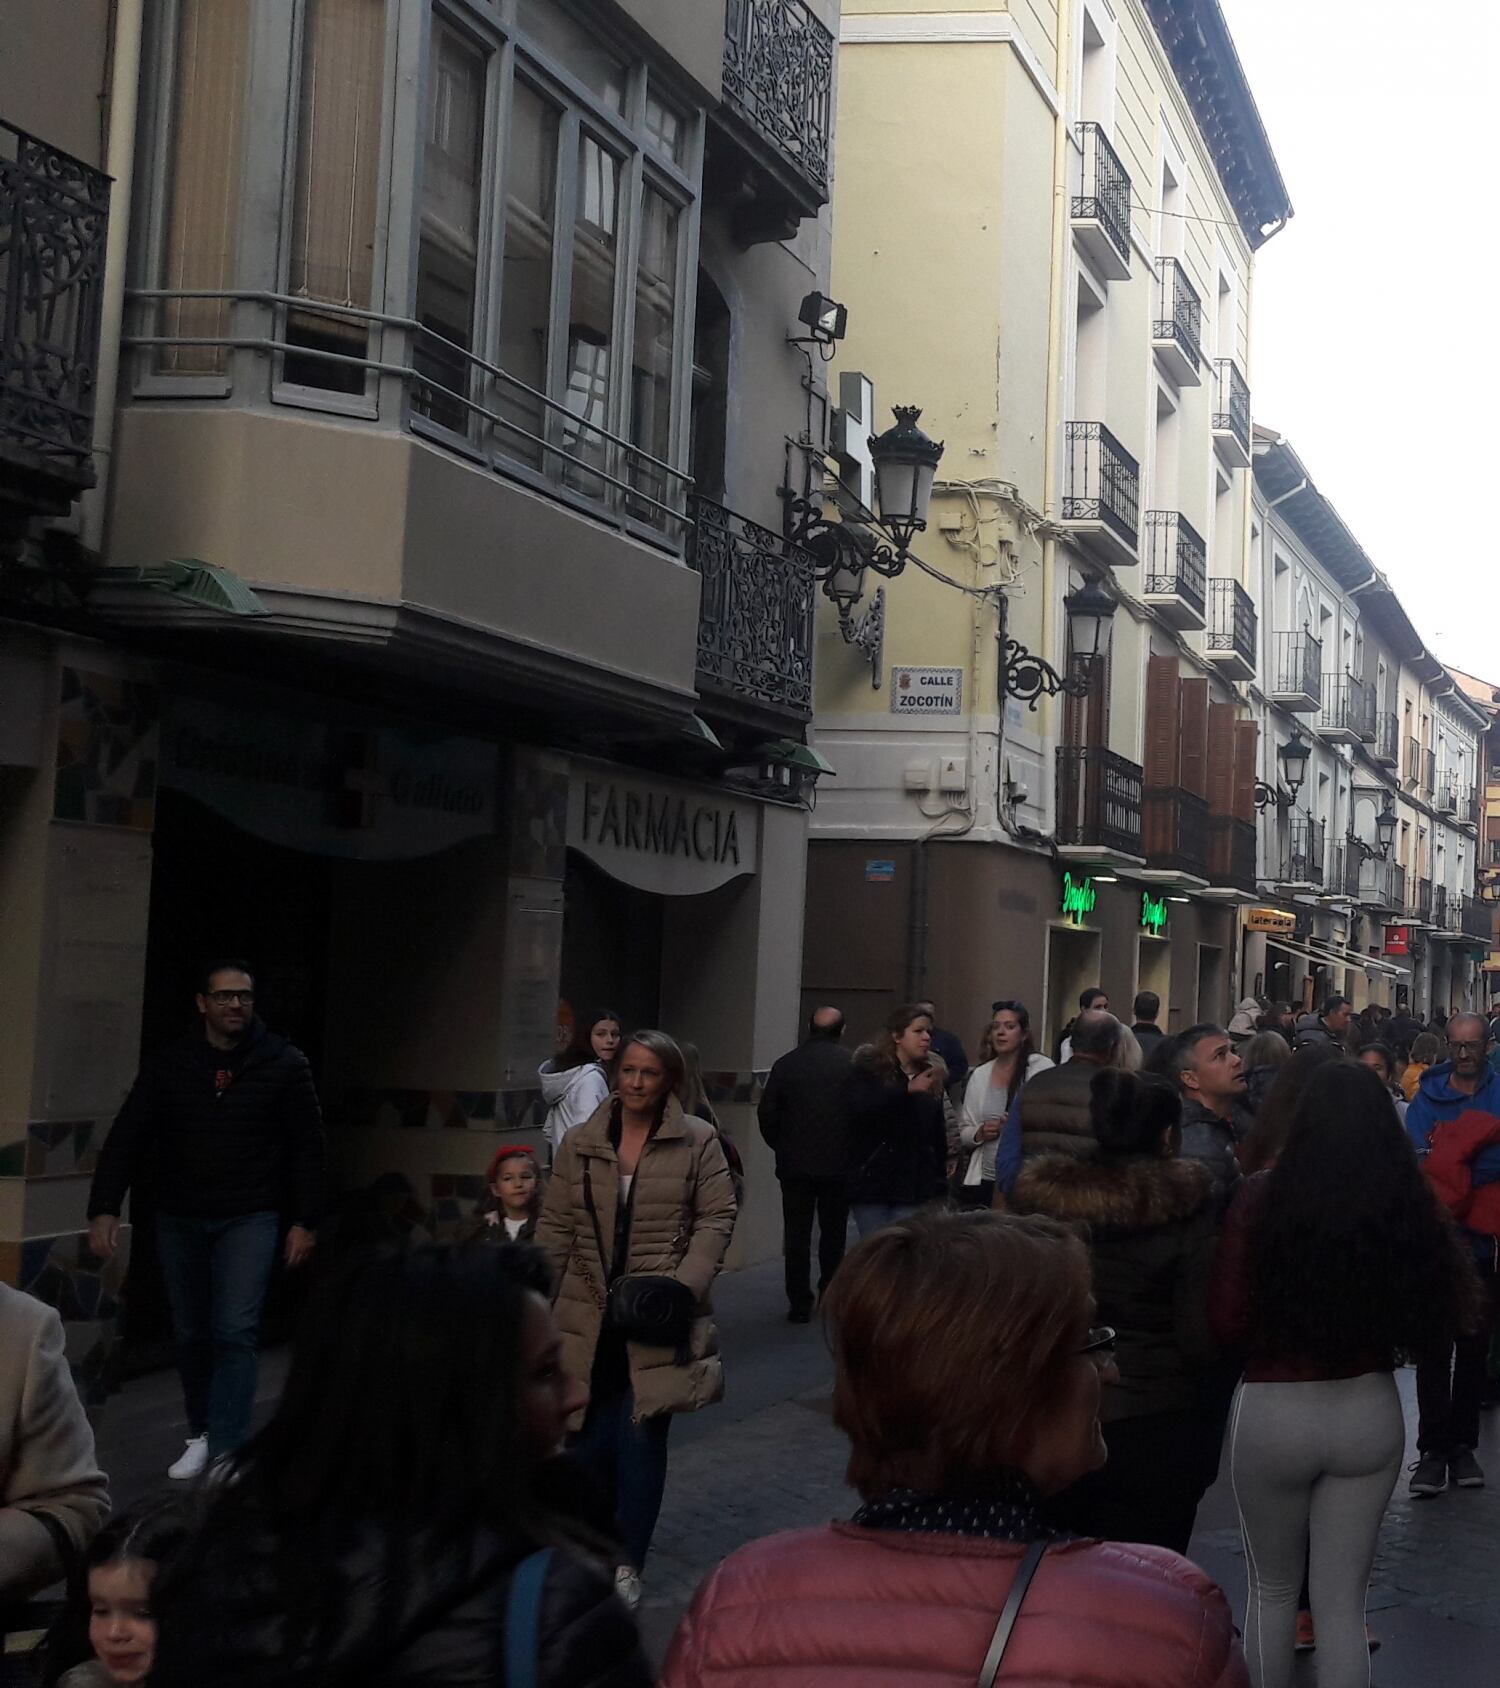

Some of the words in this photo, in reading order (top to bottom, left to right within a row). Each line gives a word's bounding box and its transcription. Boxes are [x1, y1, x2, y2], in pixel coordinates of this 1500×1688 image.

[920, 676, 954, 686] CALLE
[900, 693, 953, 707] ZOCOTÍN
[583, 781, 741, 866] FARMACIA
